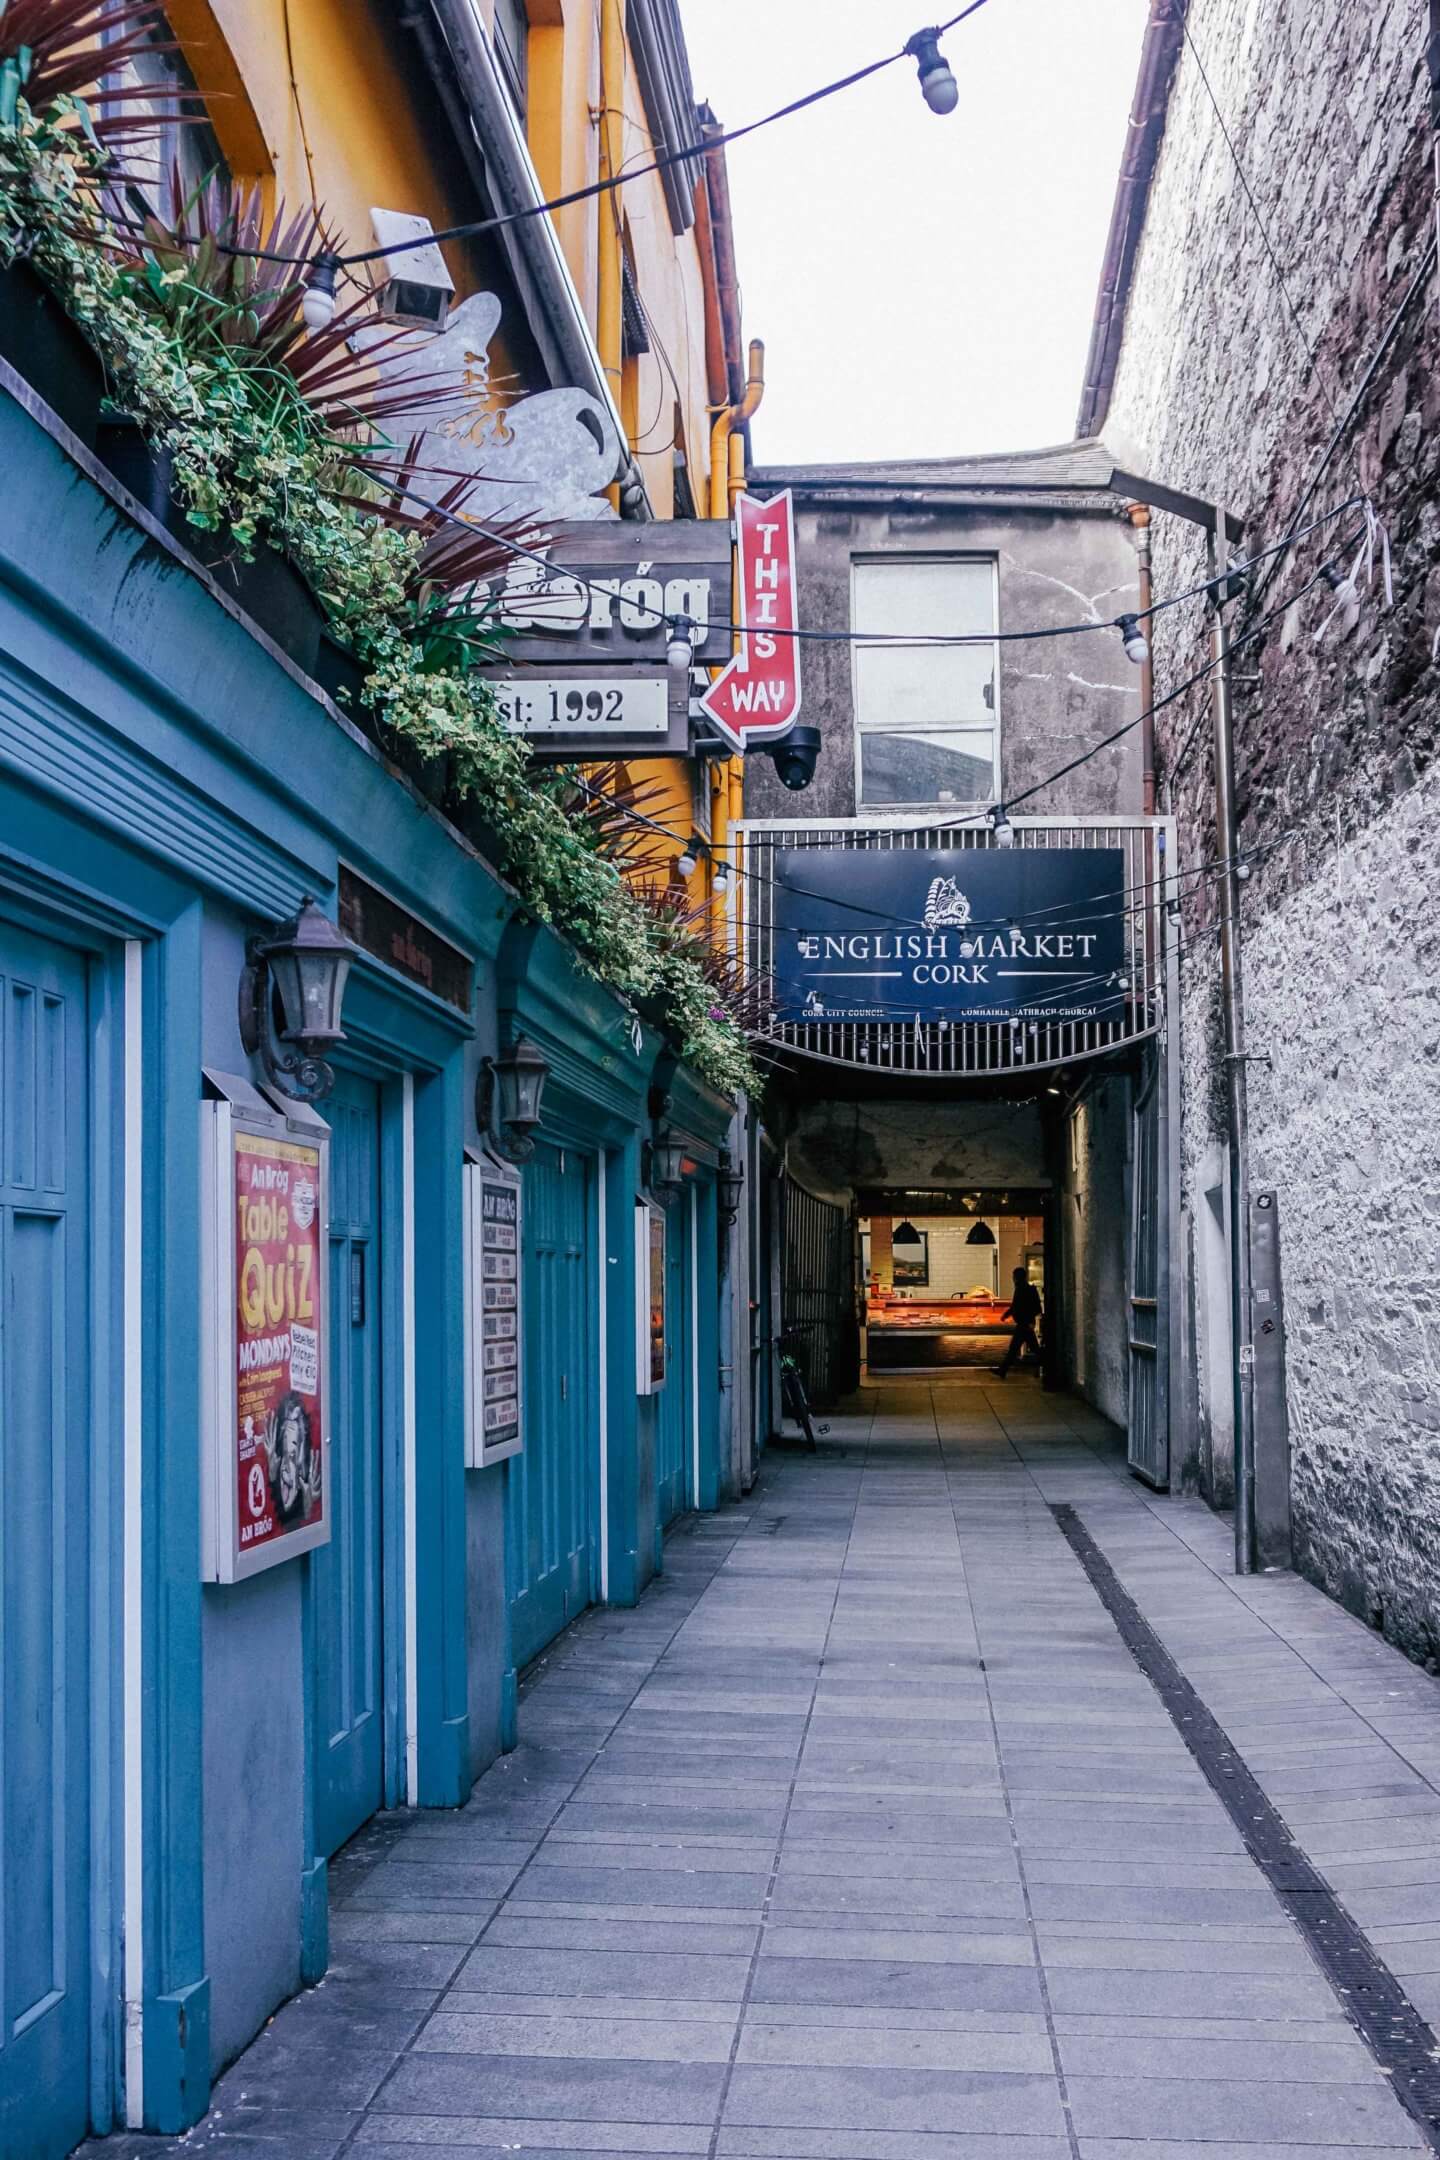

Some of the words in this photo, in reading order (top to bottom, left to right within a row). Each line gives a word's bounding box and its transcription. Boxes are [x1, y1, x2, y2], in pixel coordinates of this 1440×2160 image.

[754, 523, 780, 659] THIS
[496, 695, 533, 722] st:
[549, 690, 623, 722] 1992
[730, 680, 786, 713] WAY
[802, 935, 948, 959] ENGLISH
[959, 934, 1097, 958] MARKET
[912, 965, 990, 984] CORK
[848, 1009, 885, 1017] COUNCIL
[239, 1195, 289, 1242] Table
[239, 1332, 291, 1369] MONDAYS
